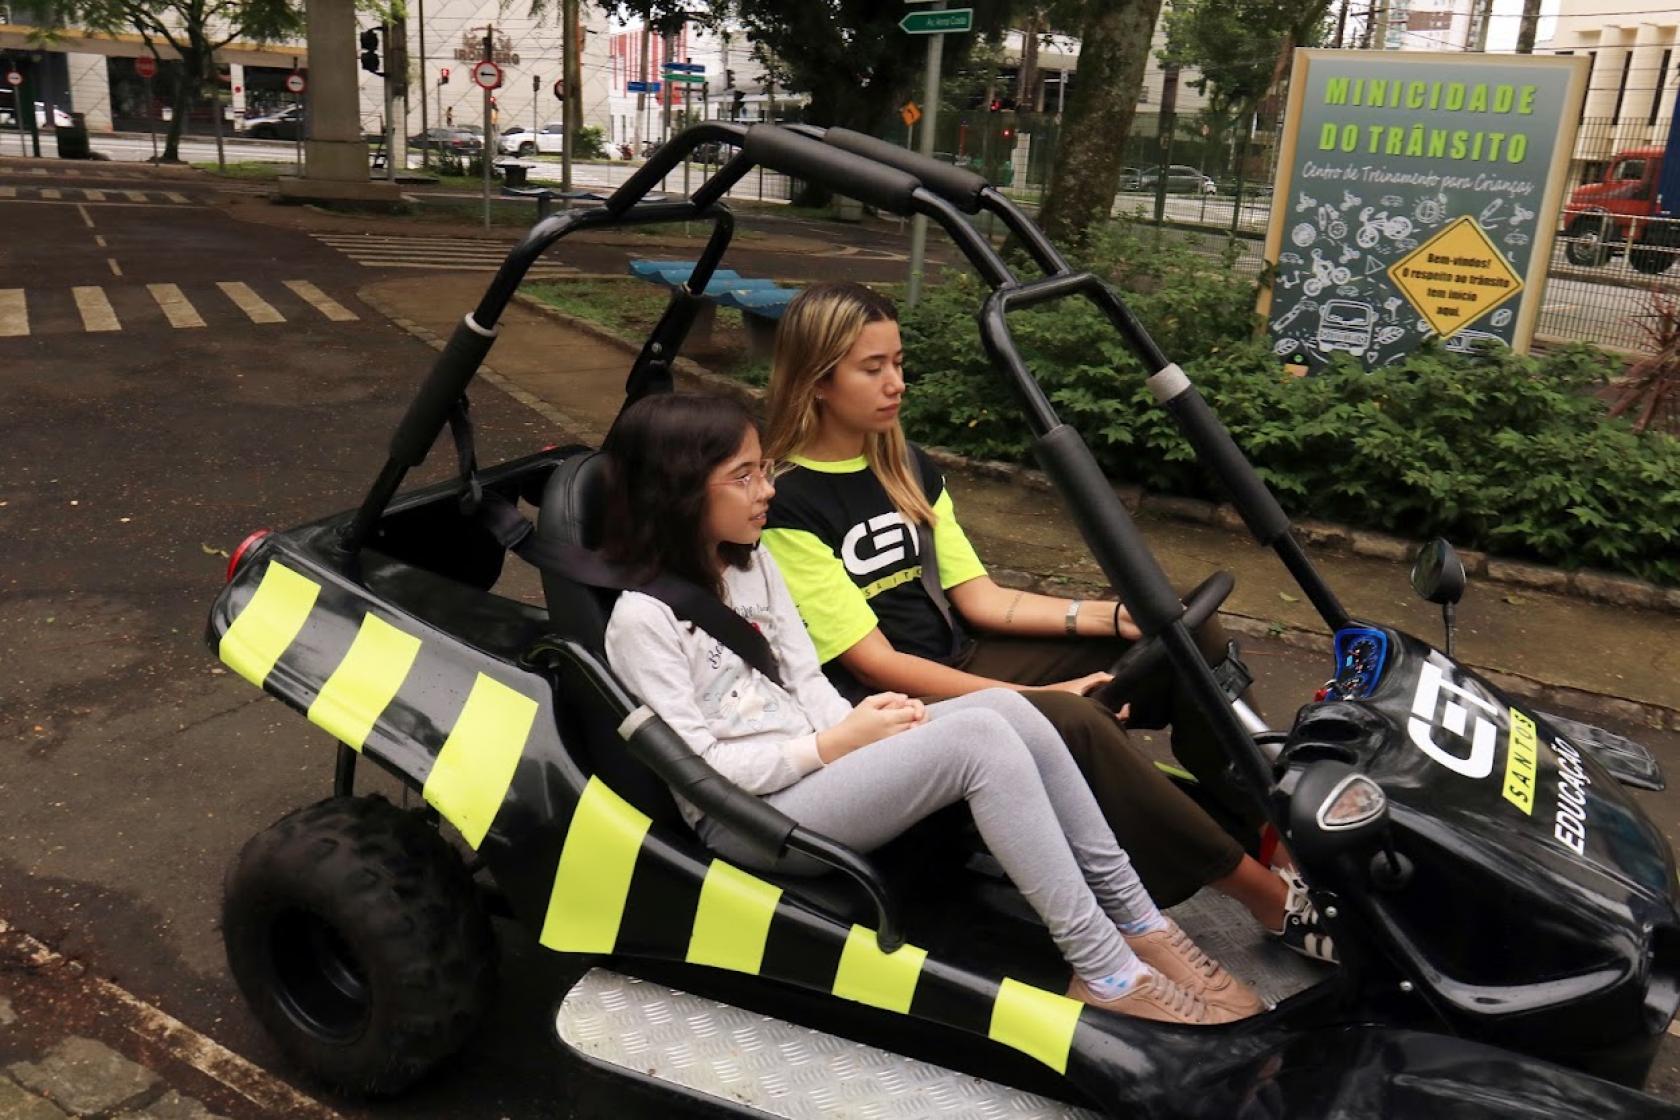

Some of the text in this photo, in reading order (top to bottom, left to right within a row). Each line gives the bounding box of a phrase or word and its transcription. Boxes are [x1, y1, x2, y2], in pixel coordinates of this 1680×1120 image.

[1324, 76, 1537, 115] MINICIDADE
[1319, 122, 1529, 164] DO TRÂNSITO
[1302, 161, 1535, 197] Centro de Treinamento para Crianças
[1411, 270, 1453, 282] respeito
[1454, 274, 1467, 284] ao
[1469, 274, 1510, 288] trânsito
[1427, 288, 1446, 298] tem
[1511, 712, 1536, 804] SANTOS
[1551, 736, 1592, 856] EDUCAÇÃO
